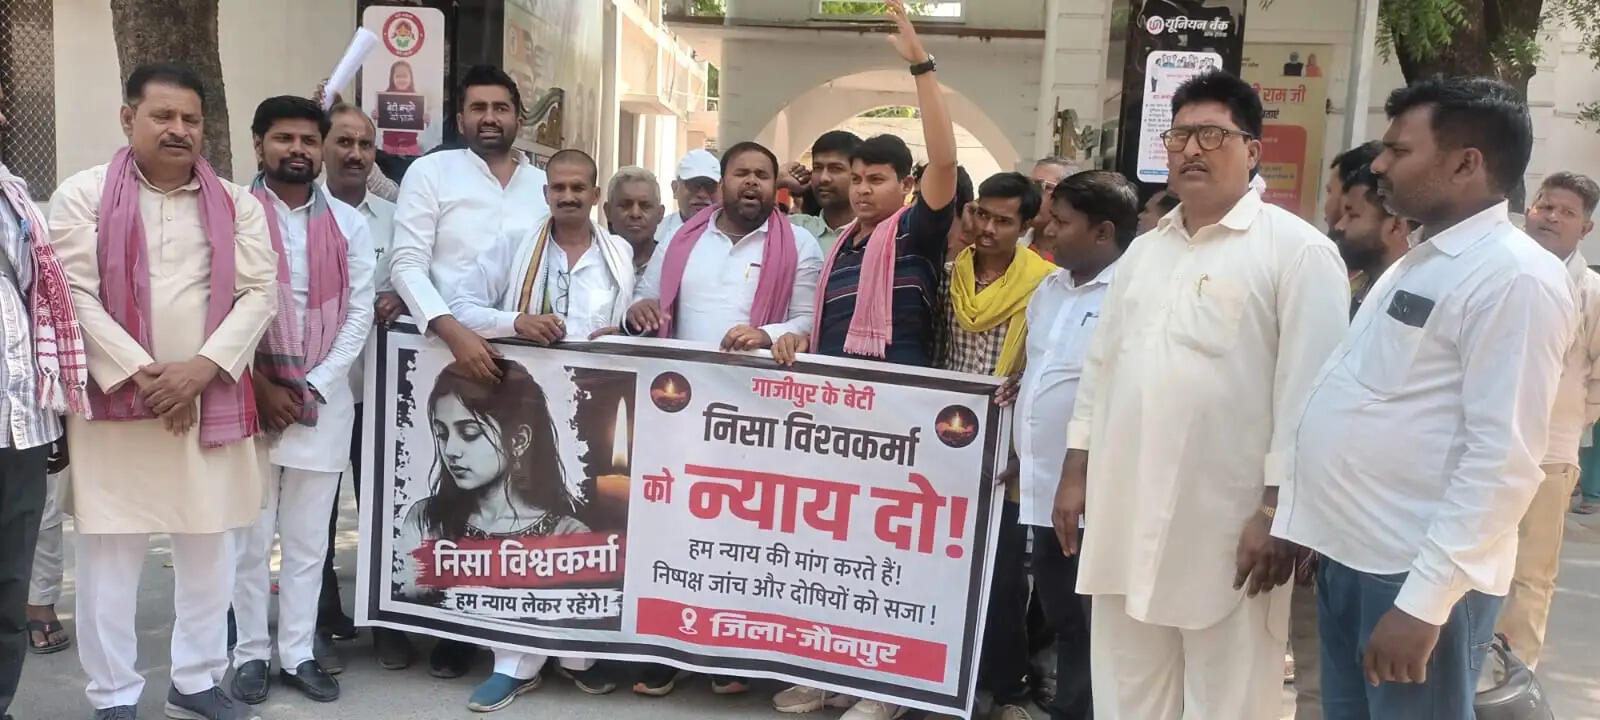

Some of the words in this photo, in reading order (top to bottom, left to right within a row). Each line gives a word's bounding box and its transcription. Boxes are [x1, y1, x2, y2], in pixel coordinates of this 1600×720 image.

[1164, 15, 1208, 34] यूनियन
[1263, 86, 1287, 104] राम
[1289, 83, 1306, 103] जी
[752, 376, 818, 407] गाजीपुर
[821, 382, 839, 410] के
[843, 385, 875, 411] बेटी
[703, 402, 778, 448] निसा
[784, 411, 921, 467] विश्वकर्मा
[642, 467, 674, 504] को
[684, 464, 860, 541] न्याय
[870, 472, 969, 559] दो!
[433, 540, 492, 577] निसा
[689, 538, 714, 560] हम
[719, 543, 760, 563] न्याय
[766, 542, 791, 568] की
[795, 549, 828, 576] मांग
[833, 556, 876, 582] करते
[455, 592, 479, 612] हम
[482, 594, 517, 612] न्याय
[521, 591, 561, 615] लेकर
[653, 560, 703, 592] निष्पक्ष
[708, 570, 748, 597] जांच
[753, 572, 785, 600] और
[790, 578, 850, 611] दोषियों
[853, 588, 880, 615] को
[884, 602, 925, 623] सजा
[929, 604, 937, 626] !
[711, 613, 899, 666] जिला-जौनपुर
